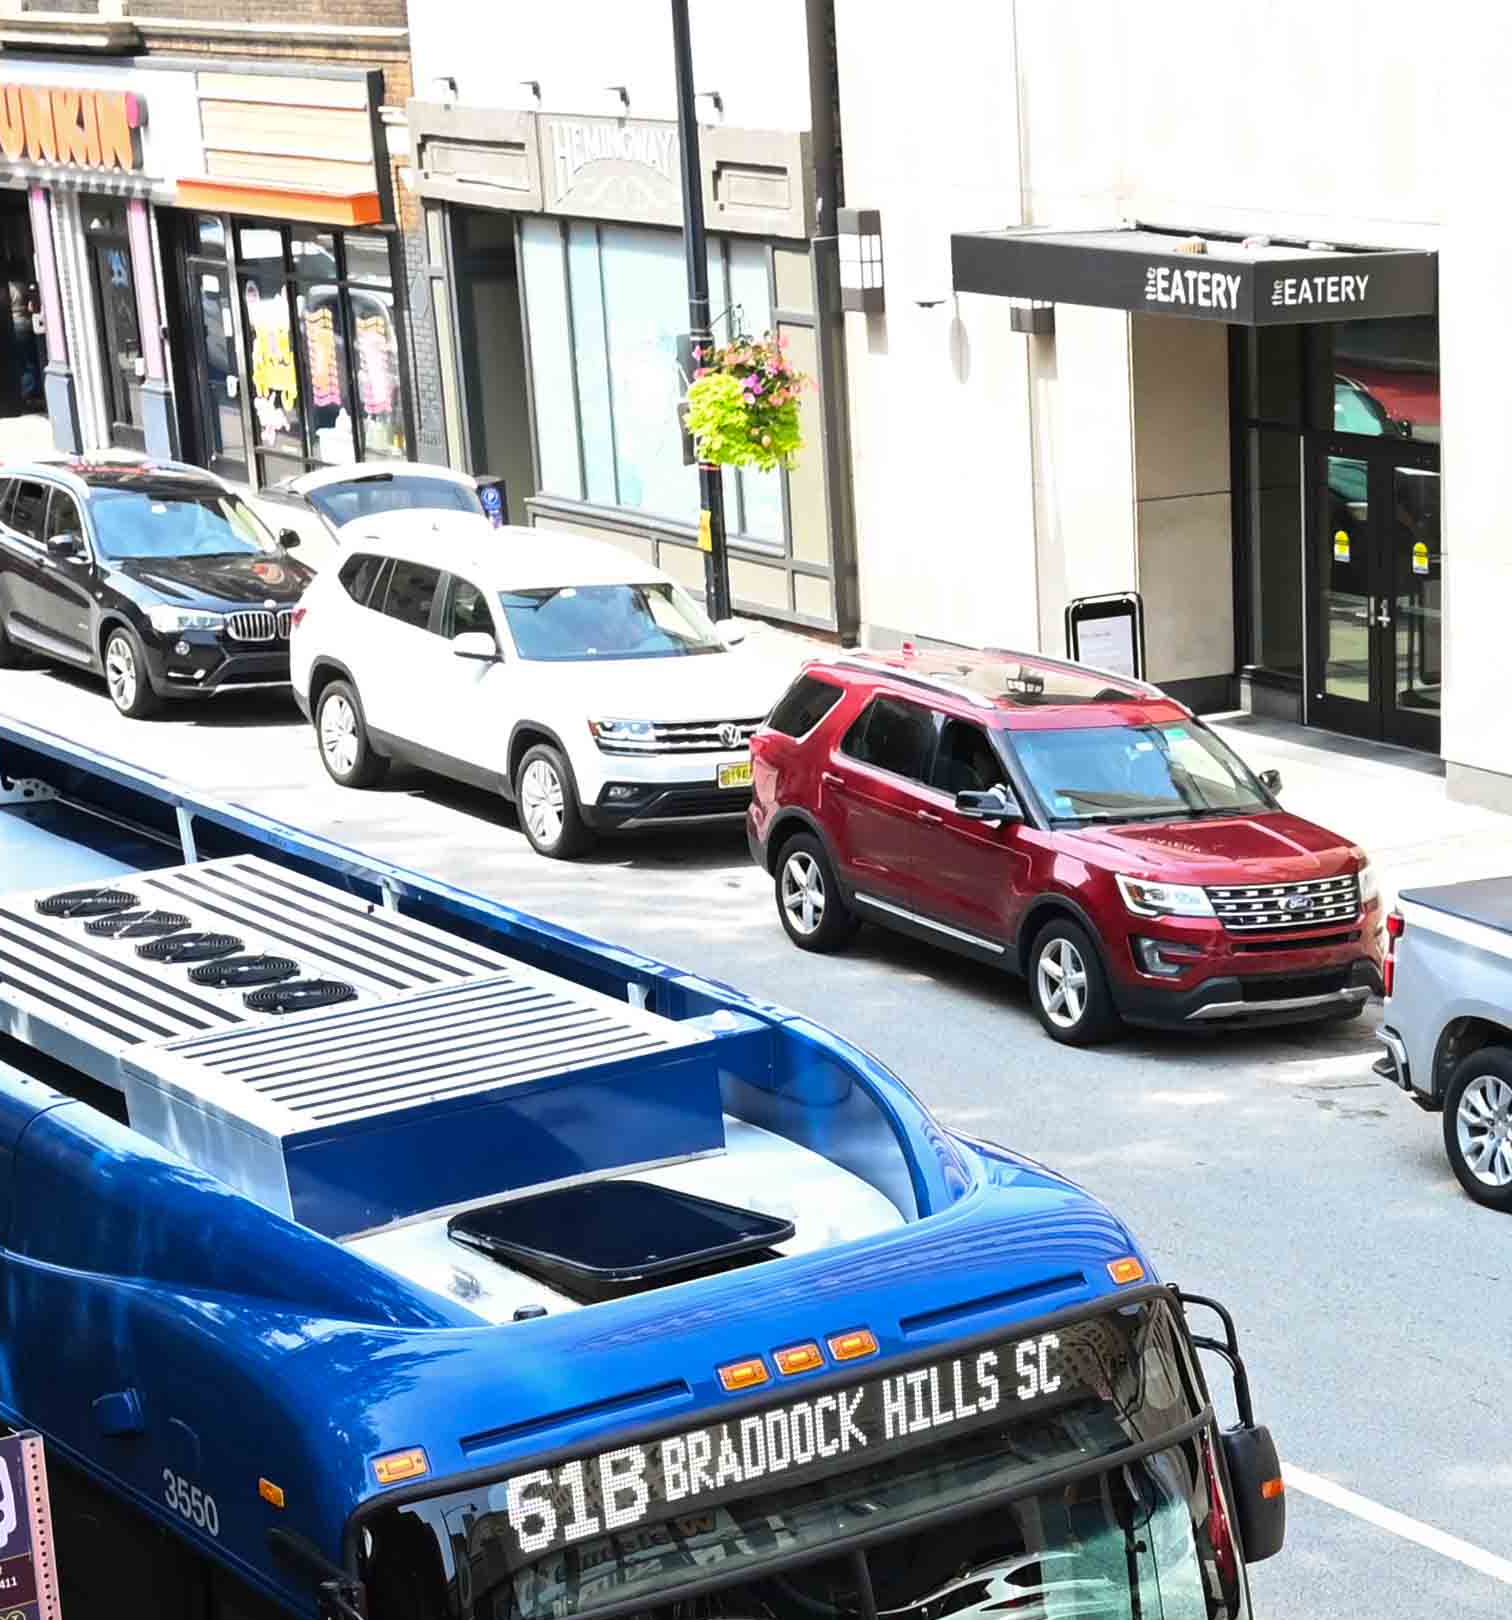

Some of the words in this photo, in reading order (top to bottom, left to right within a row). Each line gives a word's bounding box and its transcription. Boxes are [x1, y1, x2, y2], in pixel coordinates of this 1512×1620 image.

[1156, 267, 1242, 310] EATERY
[1284, 274, 1369, 305] EATERY
[506, 1444, 649, 1553] 61B
[660, 1387, 868, 1502] BRADDOCK
[882, 1351, 1000, 1440] HILLS
[1015, 1333, 1061, 1401] SC
[163, 1468, 219, 1537] 3550
